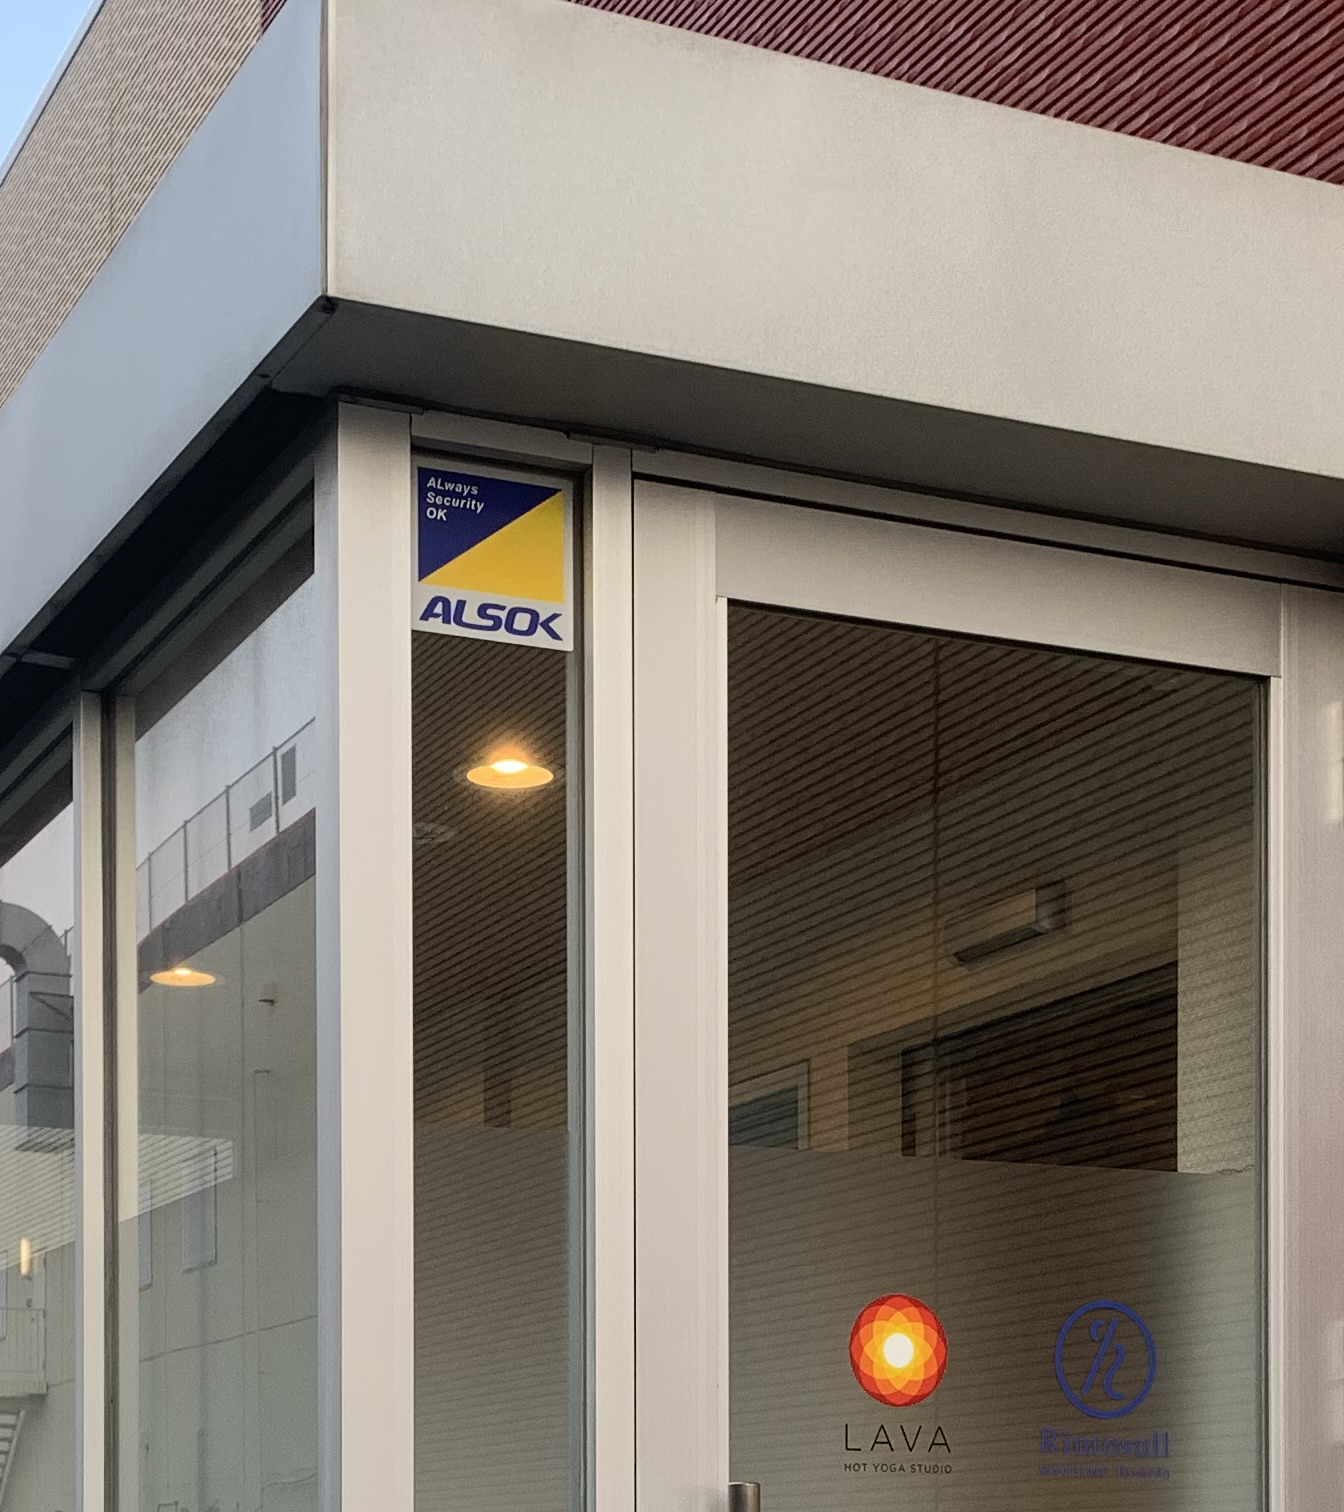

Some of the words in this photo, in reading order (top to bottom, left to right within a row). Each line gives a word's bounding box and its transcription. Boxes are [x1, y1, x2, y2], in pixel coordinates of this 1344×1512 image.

[426, 476, 479, 497] ALways
[426, 491, 485, 514] Security
[426, 507, 448, 521] OK
[419, 595, 564, 642] ALSOK
[843, 1423, 952, 1454] LAVA
[844, 1462, 868, 1473] HOT
[872, 1463, 906, 1474] YOGA
[910, 1463, 953, 1475] STUDIO
